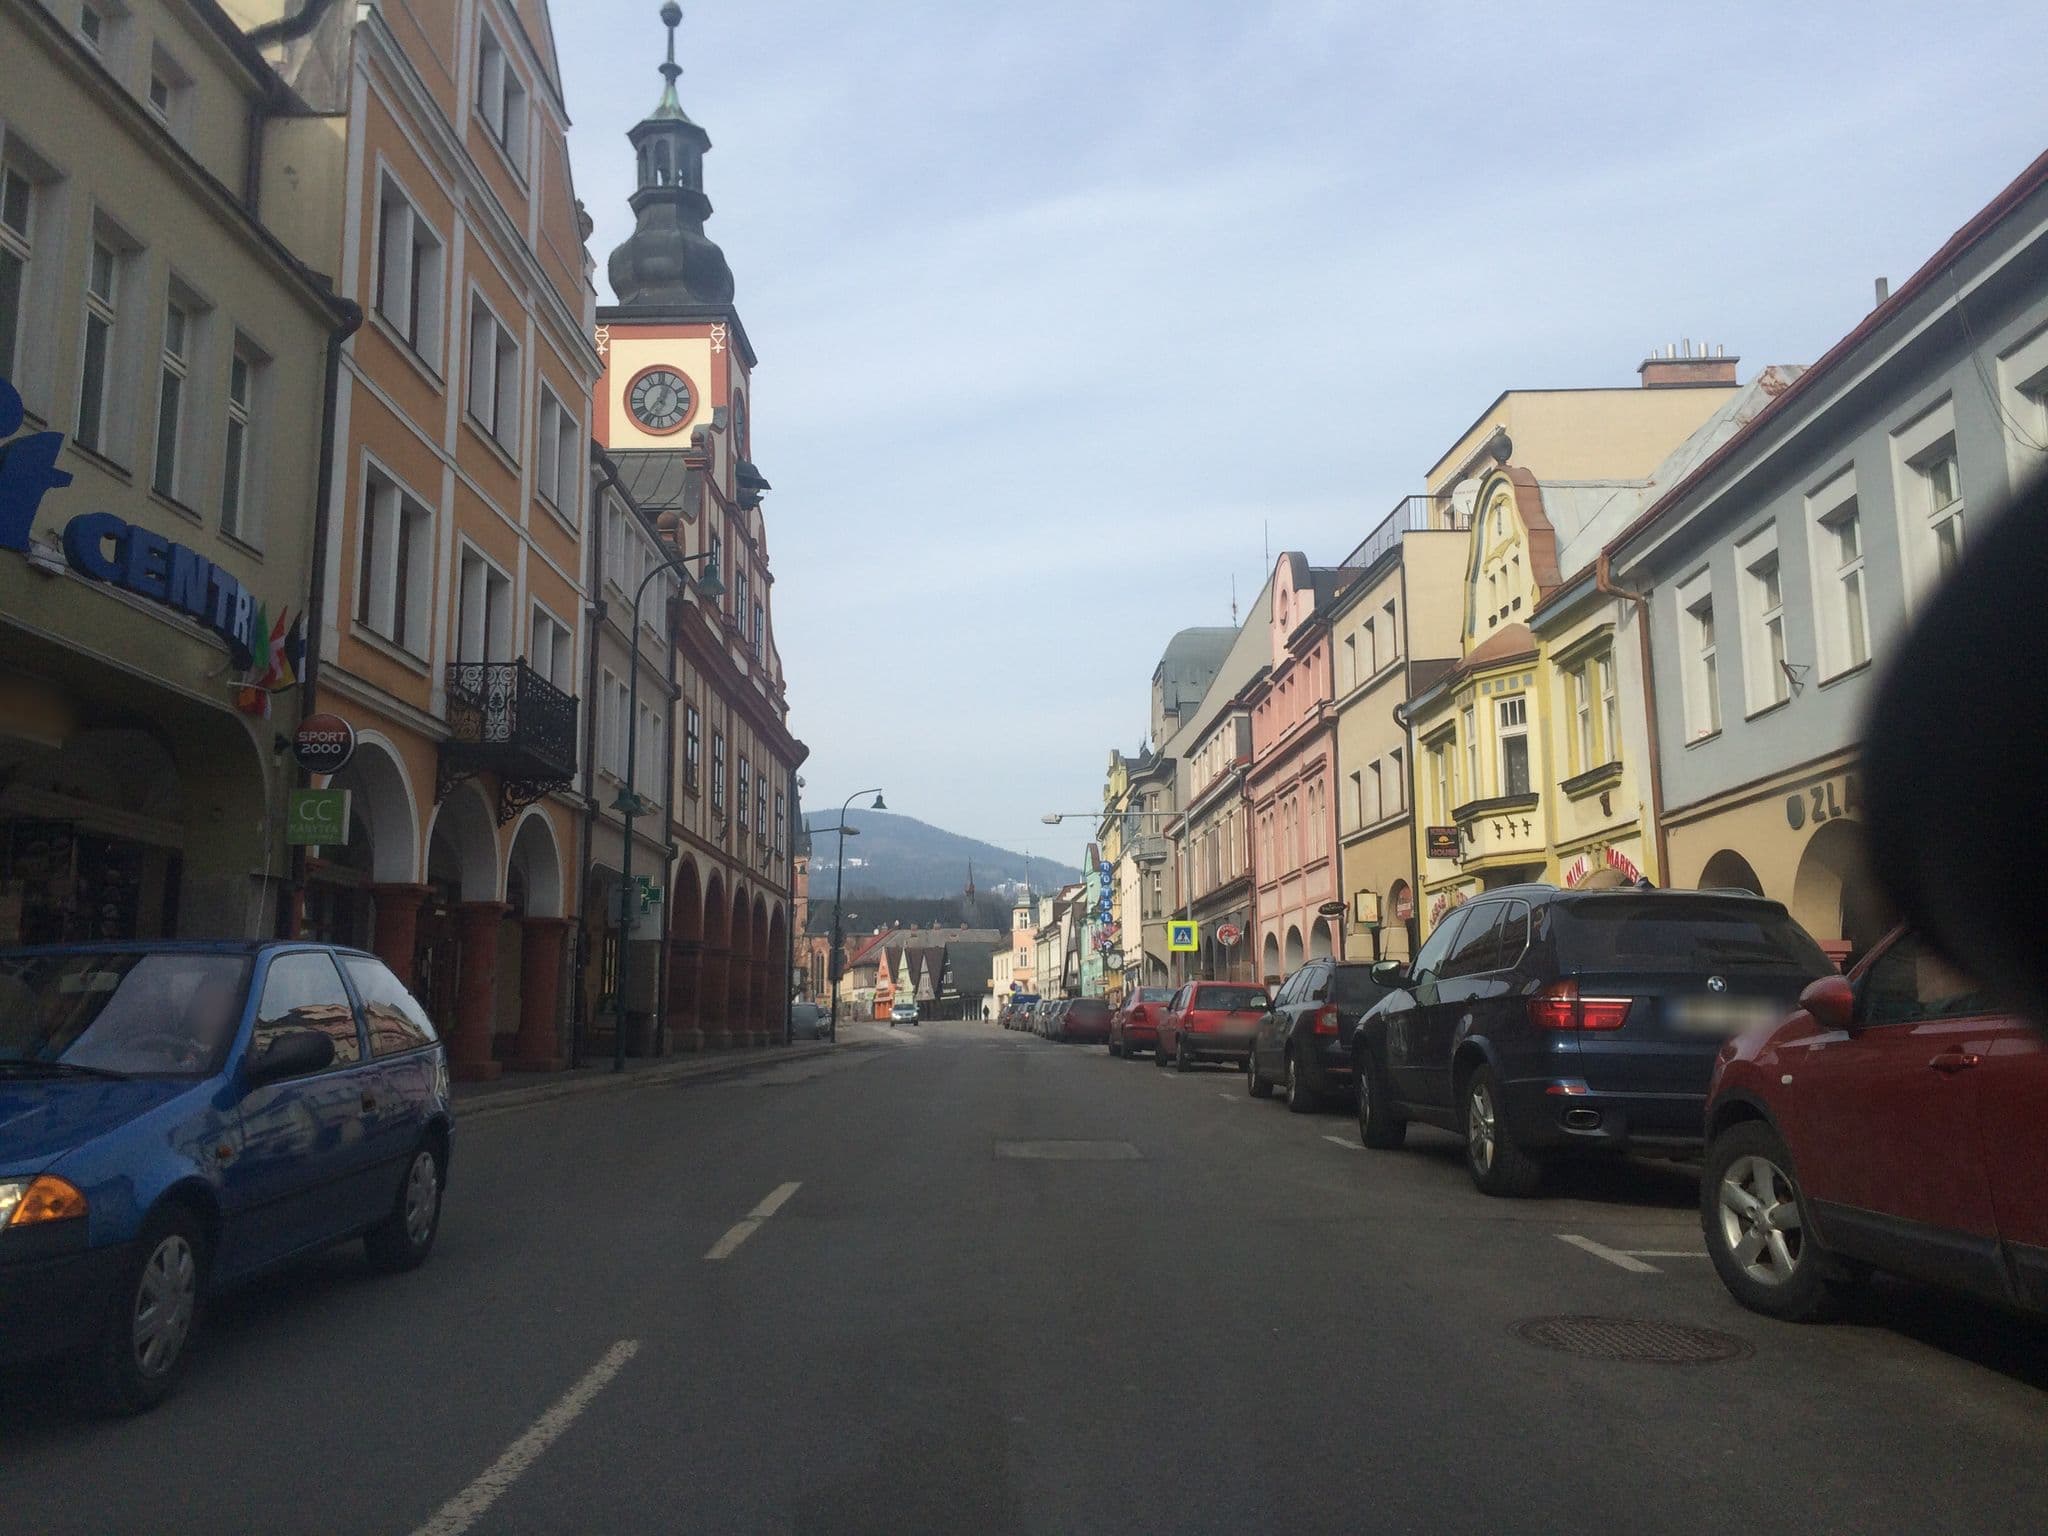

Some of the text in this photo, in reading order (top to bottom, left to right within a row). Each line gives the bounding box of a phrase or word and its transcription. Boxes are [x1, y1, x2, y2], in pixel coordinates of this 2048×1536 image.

[298, 731, 347, 743] SPORT
[300, 743, 342, 755] 2000
[298, 799, 332, 821] CC
[1430, 848, 1459, 857] HOUSE
[1566, 856, 1585, 889] MINI
[1102, 861, 1112, 922] HOTEL
